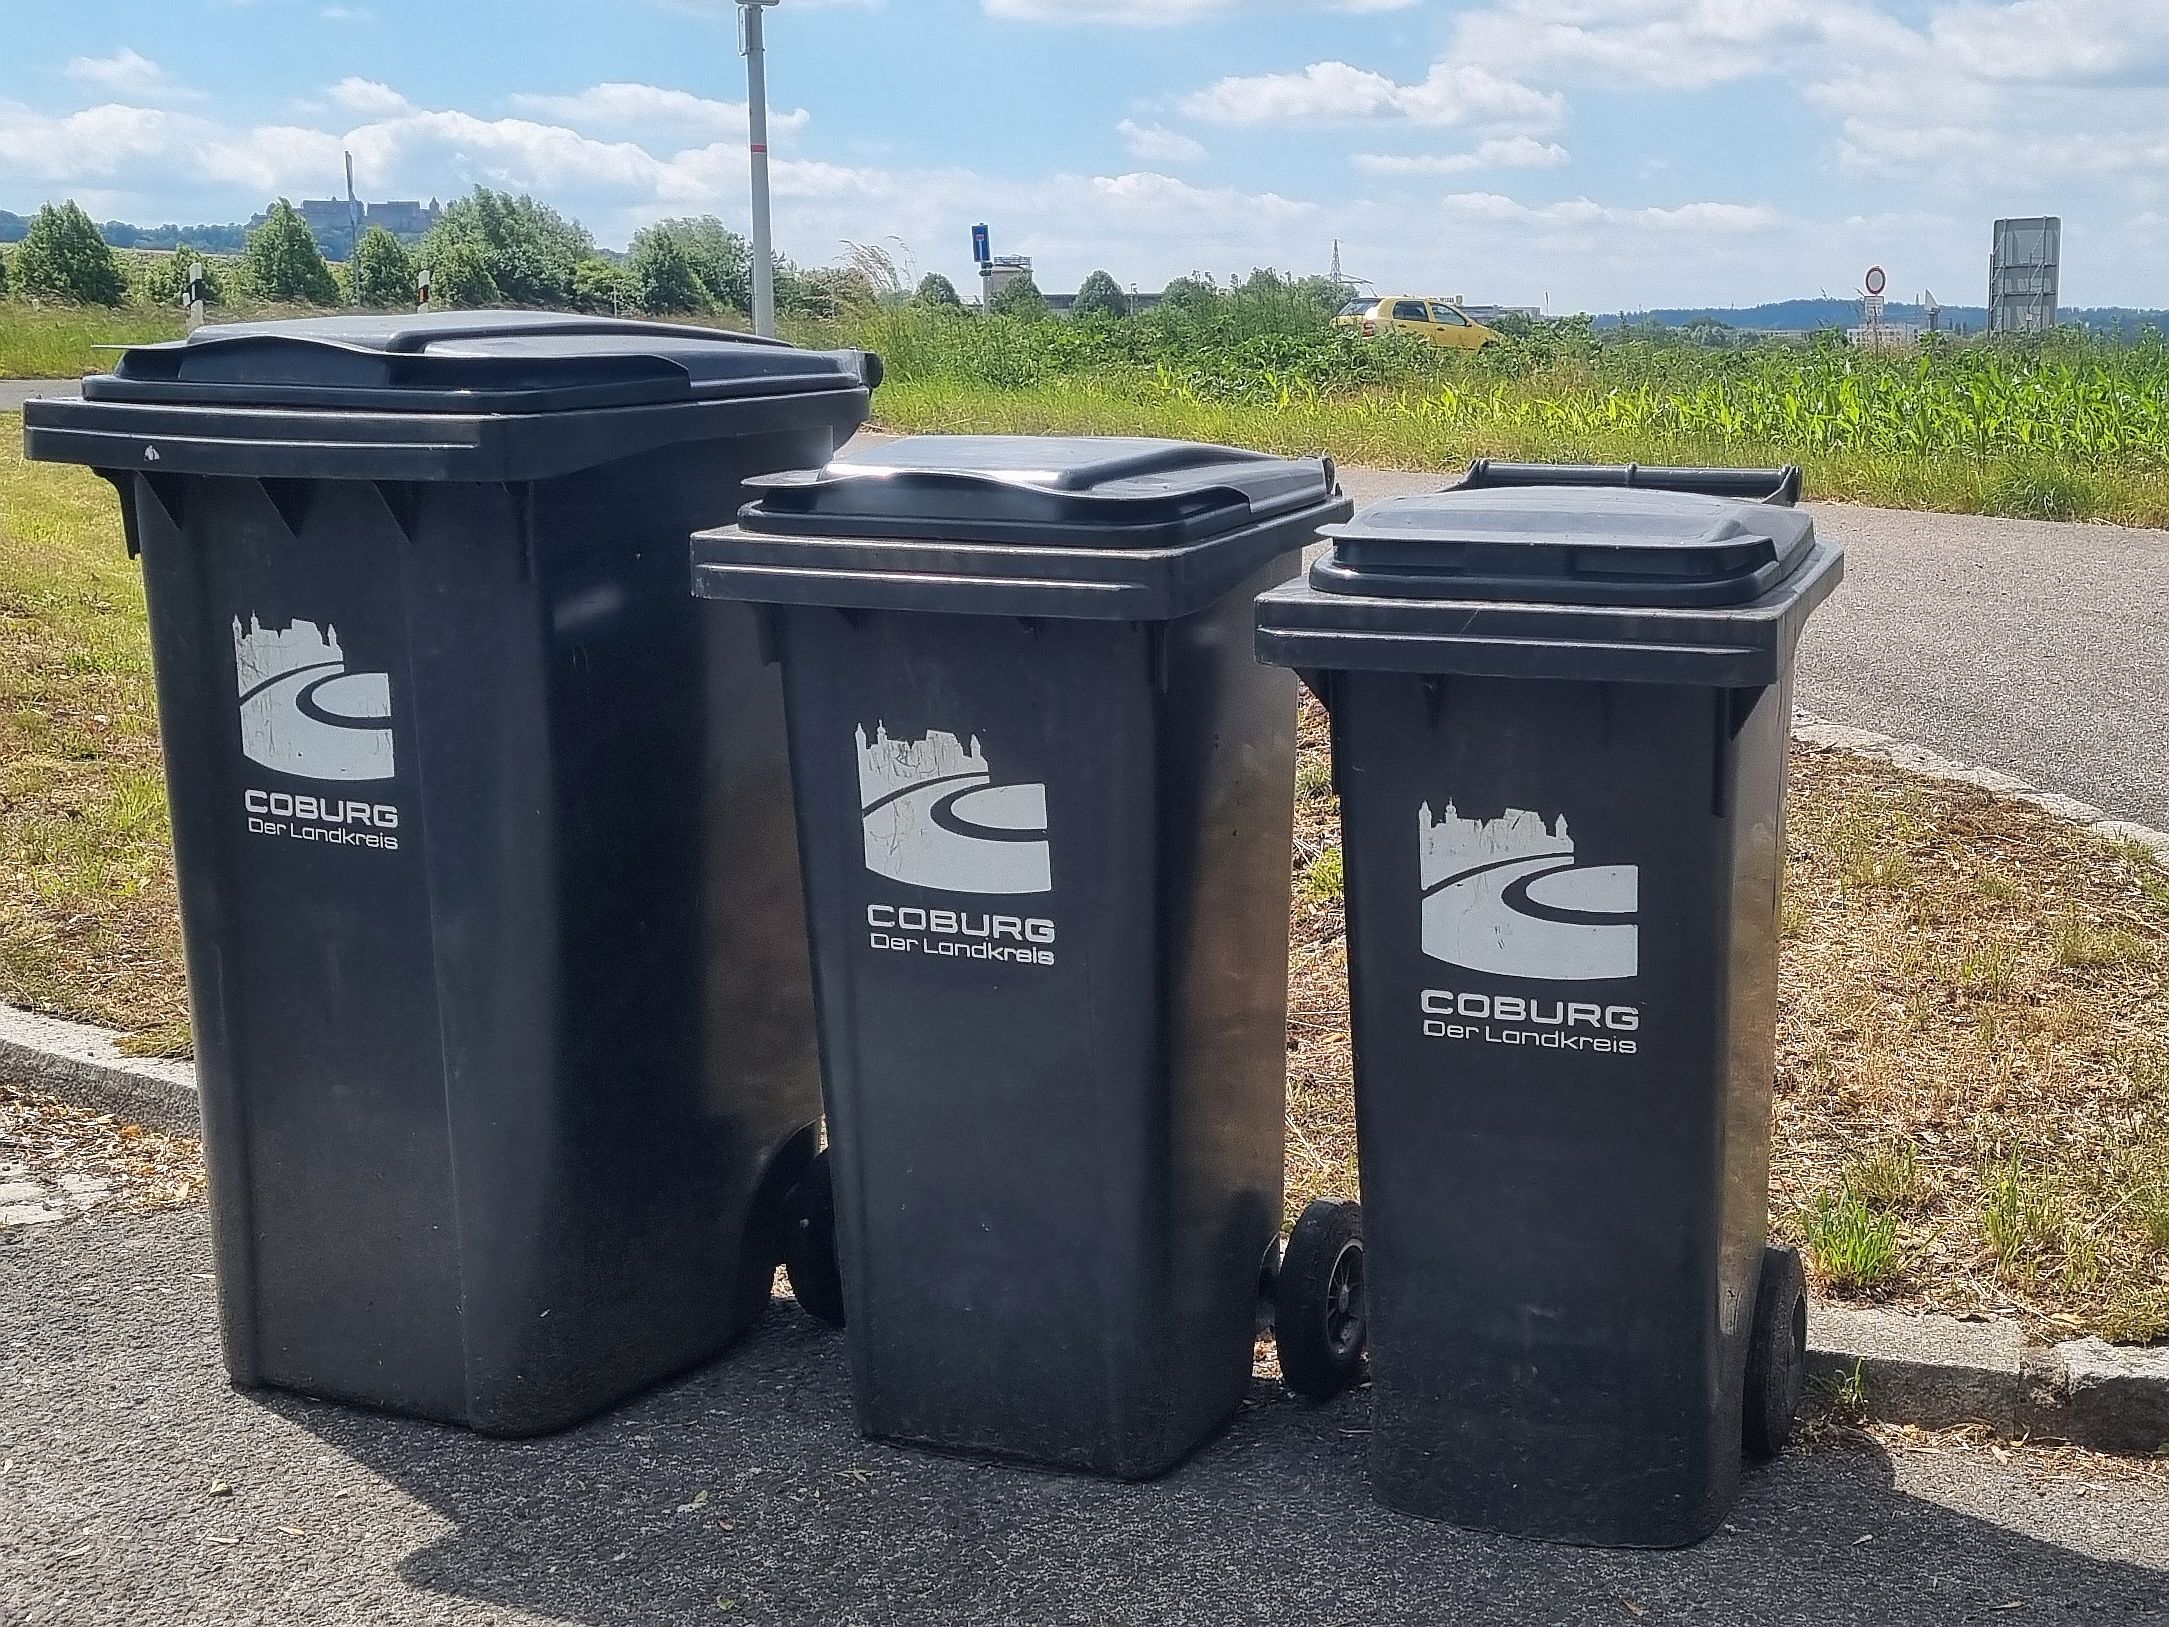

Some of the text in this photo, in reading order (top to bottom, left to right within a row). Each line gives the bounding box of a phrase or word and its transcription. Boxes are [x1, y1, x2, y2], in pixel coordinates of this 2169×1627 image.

[244, 789, 399, 829] COBURG
[248, 817, 399, 850] Der Landkreis
[867, 904, 1056, 943] COBURG
[870, 932, 1055, 966] Der Landkreis
[1420, 989, 1639, 1031] COBURG
[1423, 1019, 1638, 1054] Der Landkreis
